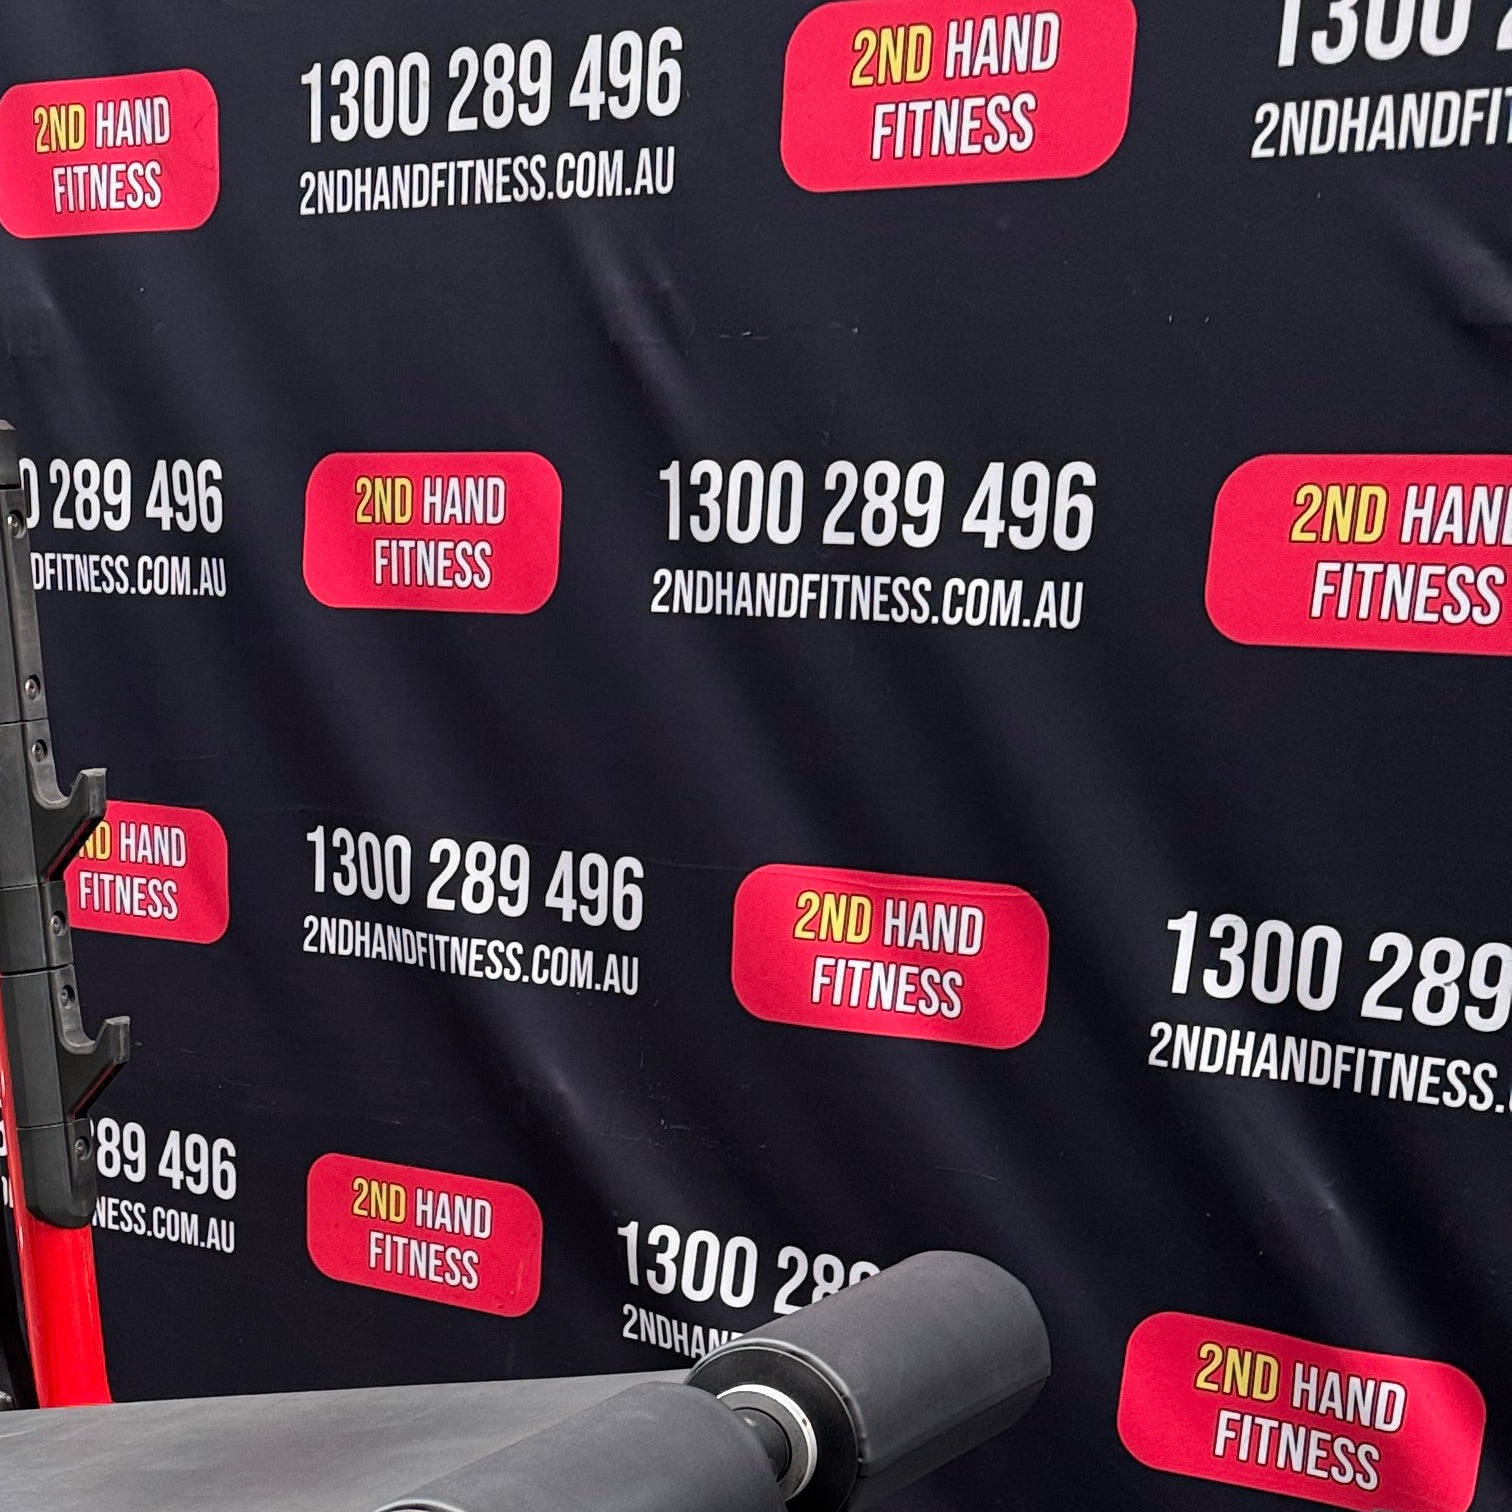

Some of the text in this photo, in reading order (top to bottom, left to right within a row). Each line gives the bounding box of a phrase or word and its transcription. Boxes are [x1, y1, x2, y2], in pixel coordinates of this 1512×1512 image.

[851, 12, 1060, 86] 2ND HAND
[301, 26, 683, 144] 1300 289 496
[34, 96, 170, 153] 2ND HAND
[872, 92, 1036, 160] FITNESS
[1251, 86, 1512, 159] 2NDHANDFI
[53, 160, 162, 213] FITNESS
[299, 145, 675, 216] 2NDHANDFITNESS.COM.AU
[49, 458, 132, 532] 289
[145, 458, 223, 534] 496
[356, 477, 505, 524] 2ND HAND
[659, 459, 1097, 552] 1300 289 496
[1291, 484, 1387, 543] 2ND
[29, 552, 227, 597] DFITNESS.COM.AU
[375, 539, 492, 589] FITNESS
[1311, 562, 1505, 625] FITNESS
[650, 568, 1084, 630] 2NDHANDFITNESS.COM.AU
[120, 822, 186, 867] HAND
[79, 871, 178, 920] FITNESS
[306, 825, 644, 931] 1300 289 496
[302, 914, 640, 996] 2NDHANDFITNESS.COM.AU
[794, 891, 984, 955] 2ND HAND
[812, 956, 963, 1018] FITNESS
[1166, 910, 1512, 1033] 1300 289
[1148, 1021, 1512, 1114] 2NDHANDFITNESS.
[89, 1117, 146, 1183] 89
[158, 1129, 237, 1200] 496
[92, 1195, 236, 1254] NESS.COM.AU
[353, 1177, 492, 1239] 2ND HAND
[369, 1231, 479, 1290] FITNESS
[617, 1220, 758, 1309] 1300
[1196, 1343, 1406, 1432] 2ND HAND
[1214, 1410, 1380, 1490] FITNESS
